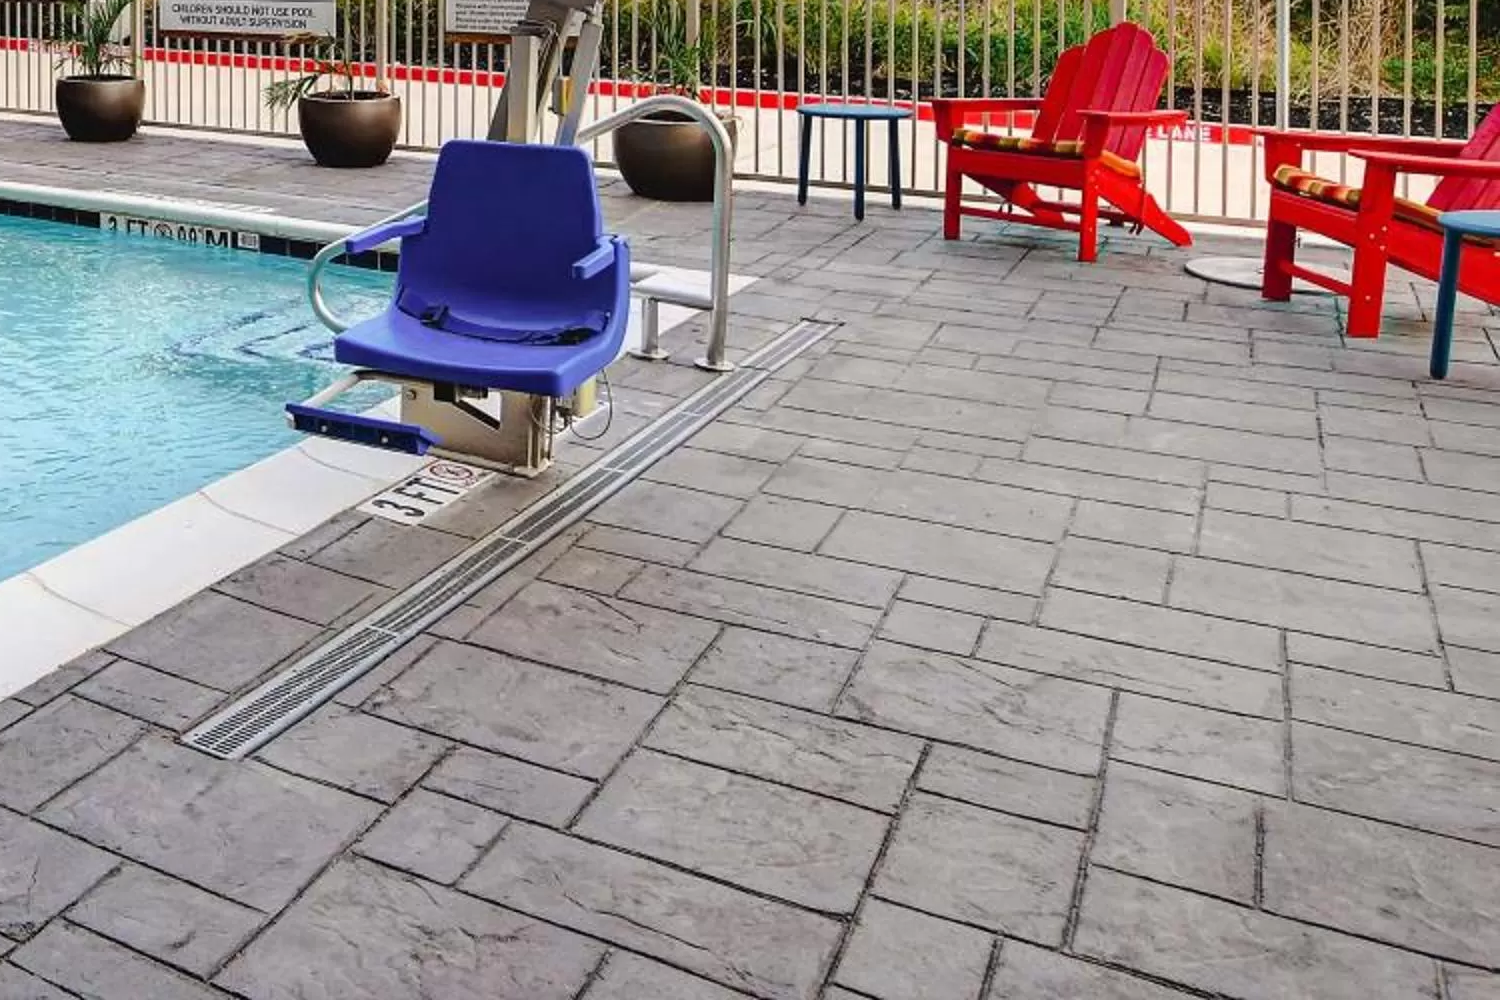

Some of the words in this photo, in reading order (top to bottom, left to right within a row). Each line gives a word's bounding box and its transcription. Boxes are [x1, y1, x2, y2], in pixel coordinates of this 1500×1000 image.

[172, 3, 213, 14] CHILDREN
[215, 5, 249, 16] SHOULD
[251, 5, 269, 16] NOT
[272, 7, 288, 17] USE
[249, 17, 307, 29] SUPERVISION
[1157, 123, 1211, 142] LANE
[392, 477, 461, 505] FT
[371, 499, 425, 517] 3
